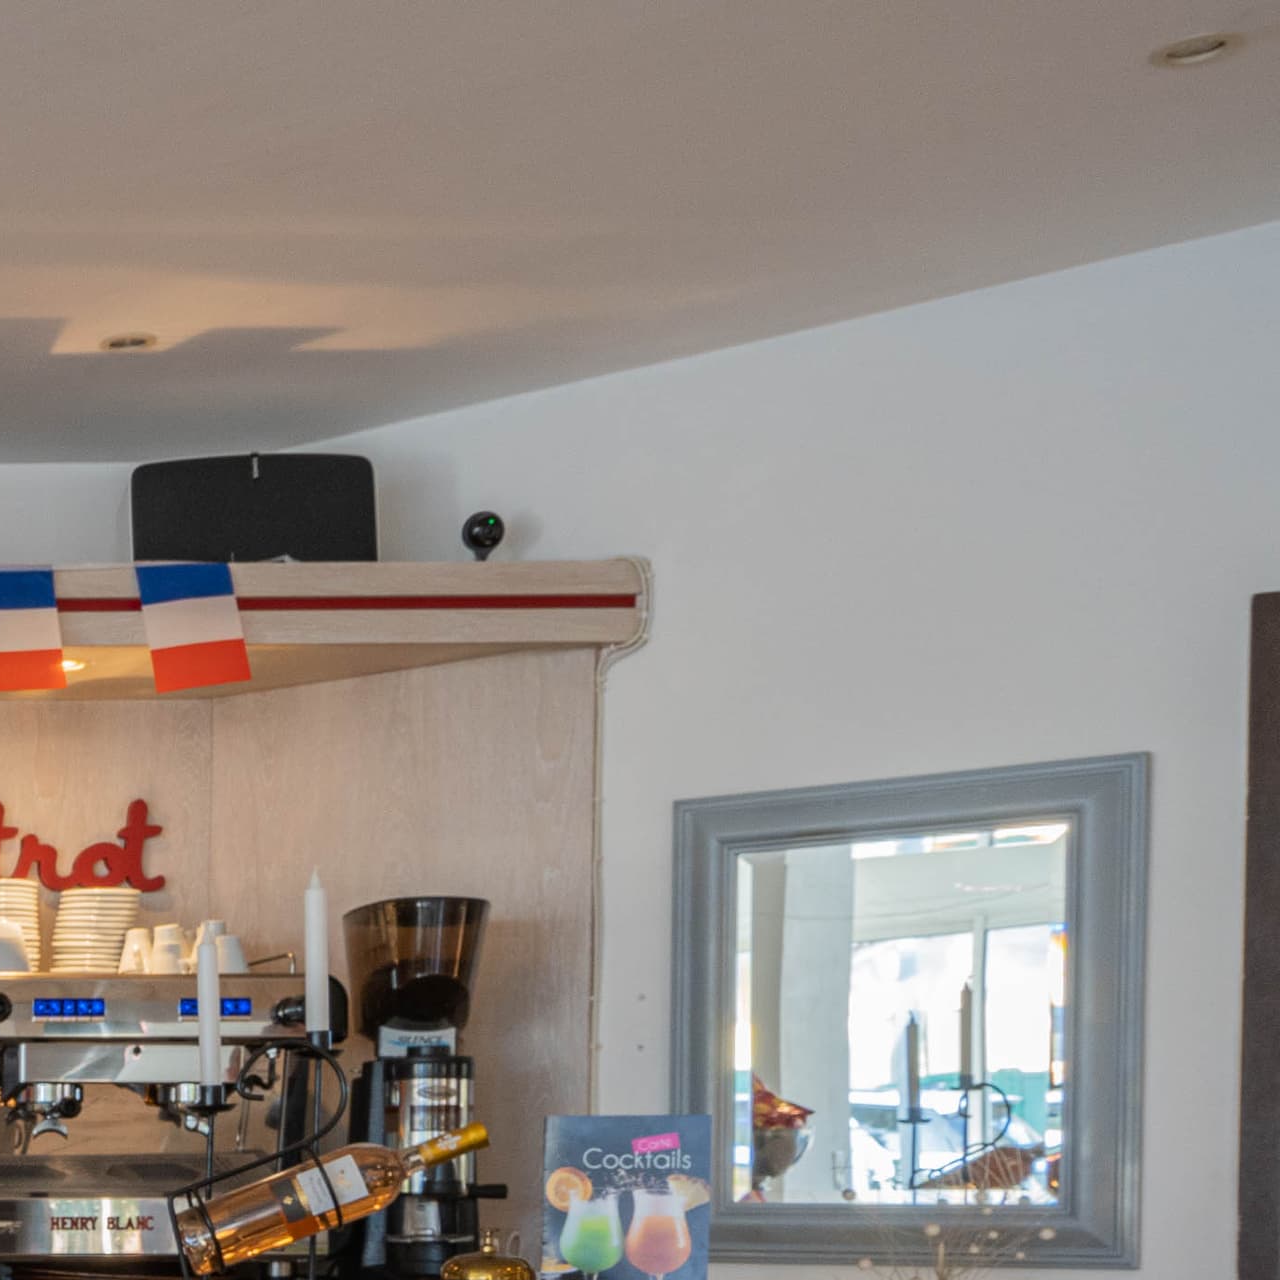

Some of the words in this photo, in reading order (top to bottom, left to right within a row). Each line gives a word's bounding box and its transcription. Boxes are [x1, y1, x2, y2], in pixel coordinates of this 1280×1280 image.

[582, 1147, 692, 1170] Cocktails
[50, 1216, 98, 1231] HENRY
[107, 1216, 155, 1231] BLANC
